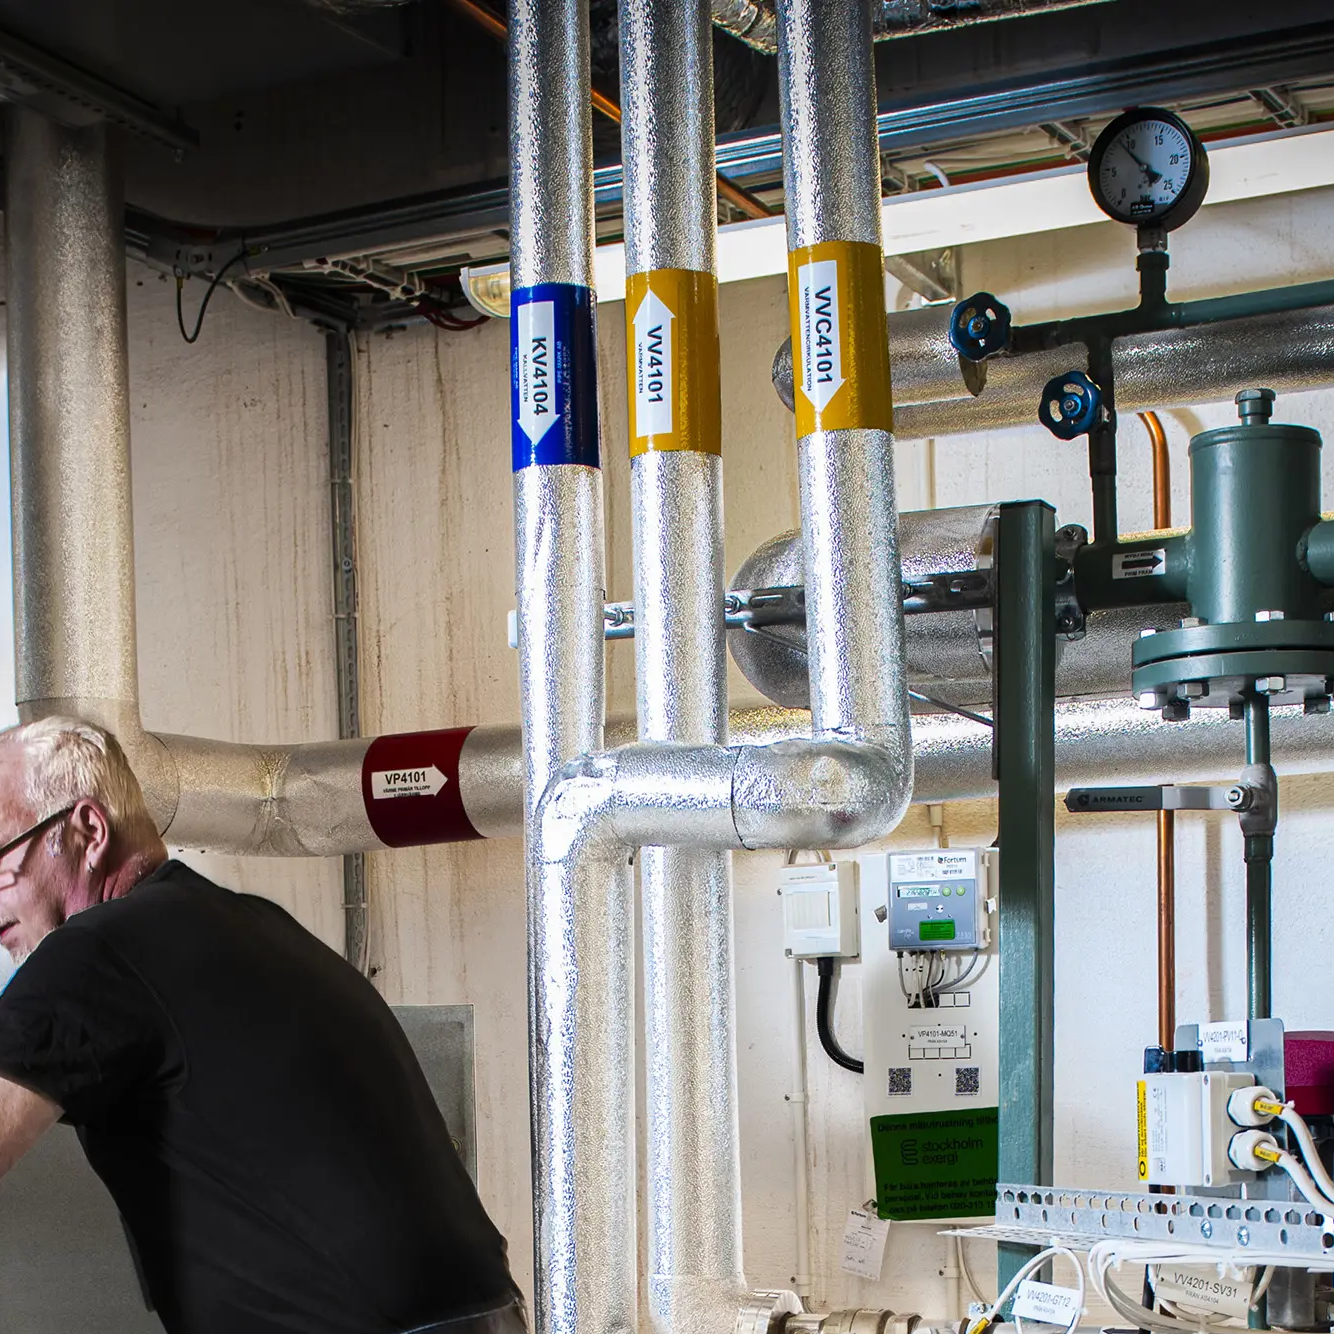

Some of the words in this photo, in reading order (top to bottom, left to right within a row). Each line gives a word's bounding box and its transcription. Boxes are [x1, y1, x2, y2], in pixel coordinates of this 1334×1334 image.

[1155, 135, 1163, 146] 15
[1170, 154, 1179, 165] 20
[1111, 167, 1117, 177] 5
[1163, 180, 1173, 190] 25
[814, 285, 833, 383] VVC4101
[647, 324, 664, 403] VV4101
[531, 336, 549, 416] KV4104
[385, 771, 427, 785] VP4101
[1091, 795, 1143, 804] ARMATEC
[943, 856, 967, 864] Fortum
[917, 1030, 958, 1038] VP4101-MQ51
[921, 1136, 984, 1152] stockholm
[921, 1151, 958, 1165] exergi
[1173, 1272, 1238, 1299] VV4201-SV31
[1026, 1288, 1072, 1308] VV4201-GT12
